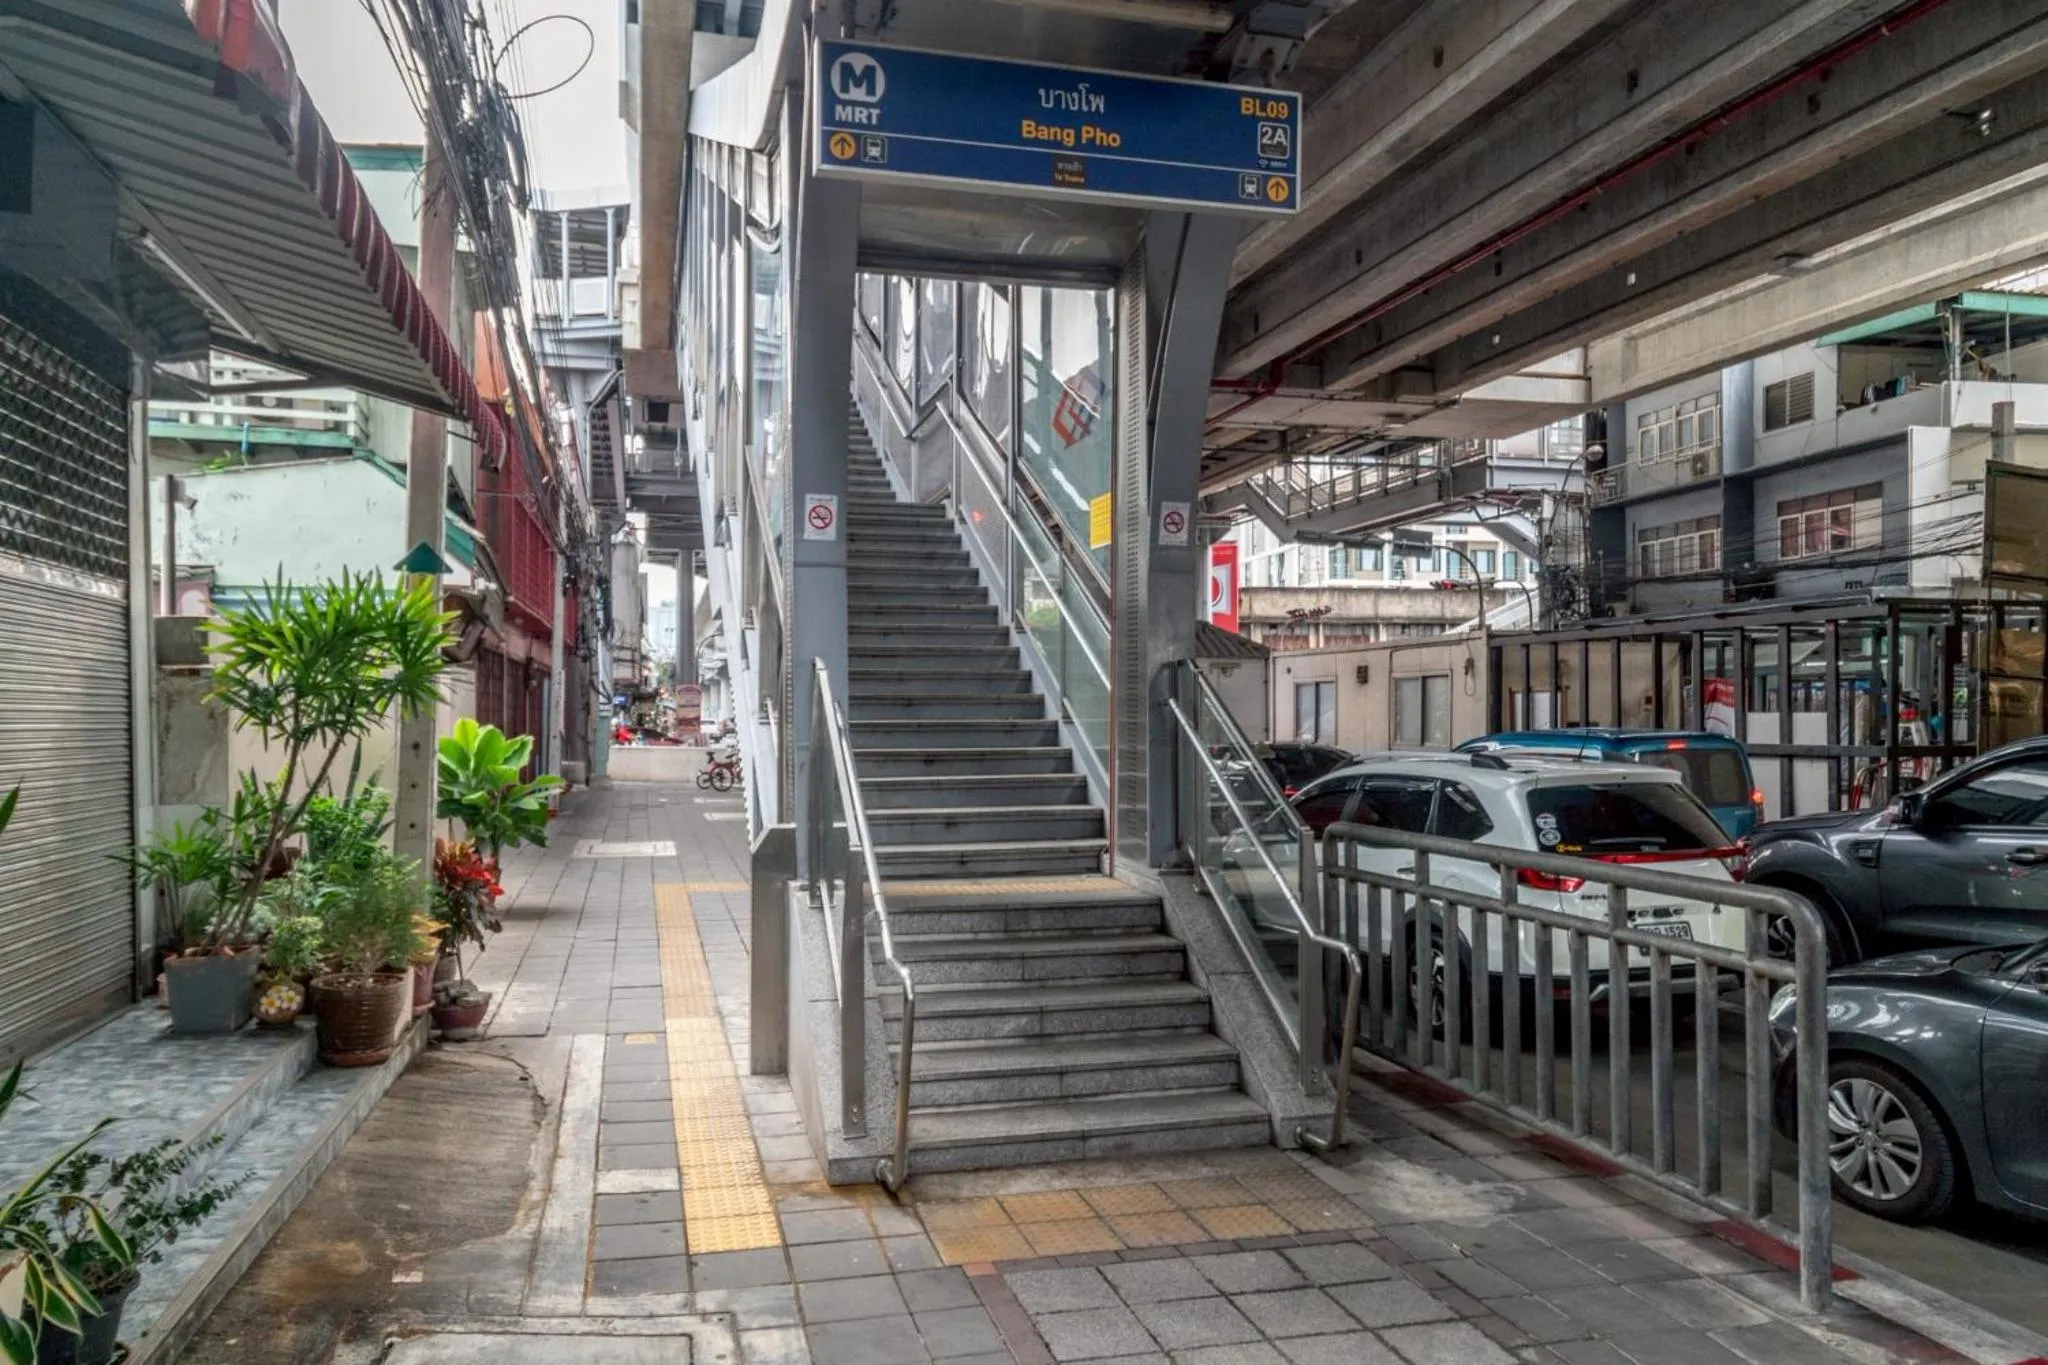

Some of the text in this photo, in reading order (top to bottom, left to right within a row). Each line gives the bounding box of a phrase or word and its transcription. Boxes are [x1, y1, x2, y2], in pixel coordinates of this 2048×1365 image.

[1038, 83, 1105, 114] บางโพ
[1241, 97, 1288, 119] BL09
[834, 104, 881, 125] MRT
[1022, 119, 1121, 147] Bang Pho
[1261, 126, 1287, 146] 2A
